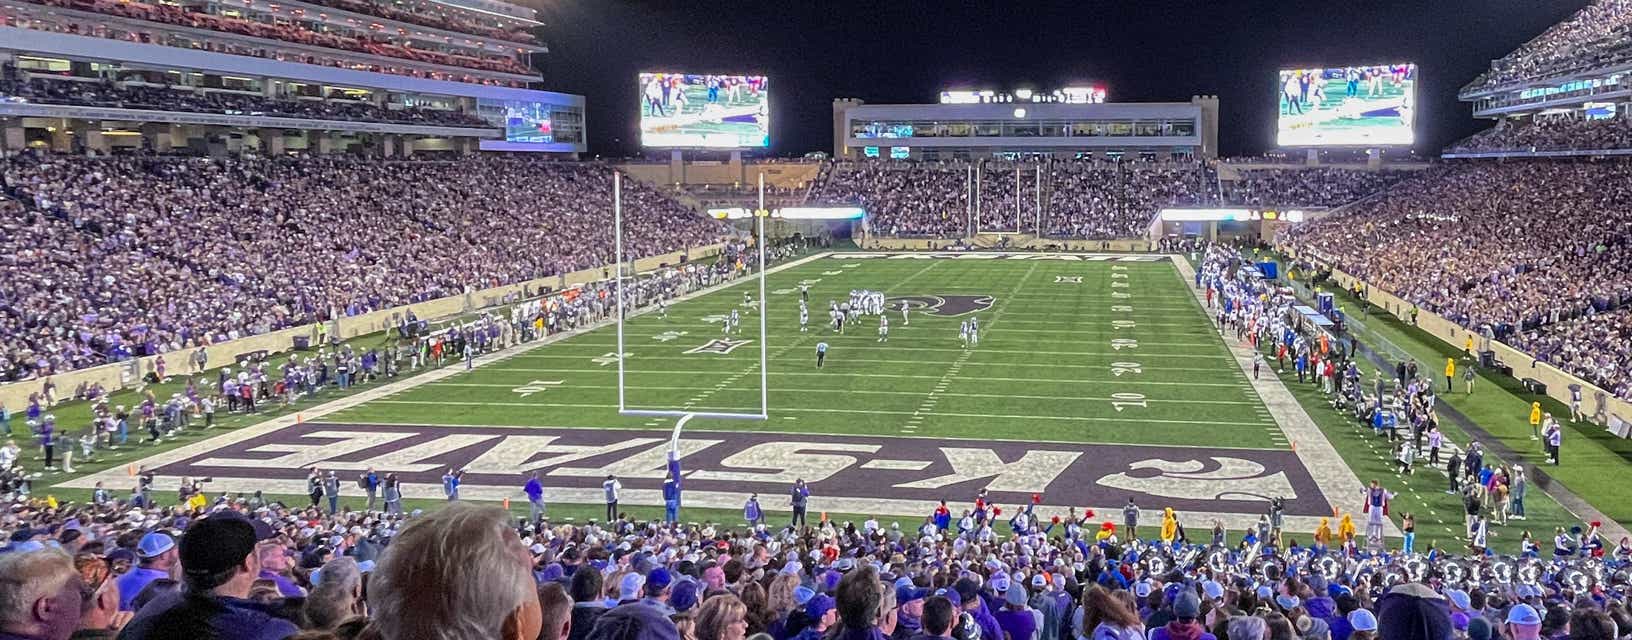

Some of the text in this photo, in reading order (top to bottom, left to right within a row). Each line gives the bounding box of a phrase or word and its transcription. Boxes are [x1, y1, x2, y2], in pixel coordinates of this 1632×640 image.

[1111, 362, 1142, 374] 20
[1111, 393, 1147, 409] 10
[190, 430, 1084, 493] K-STATE
